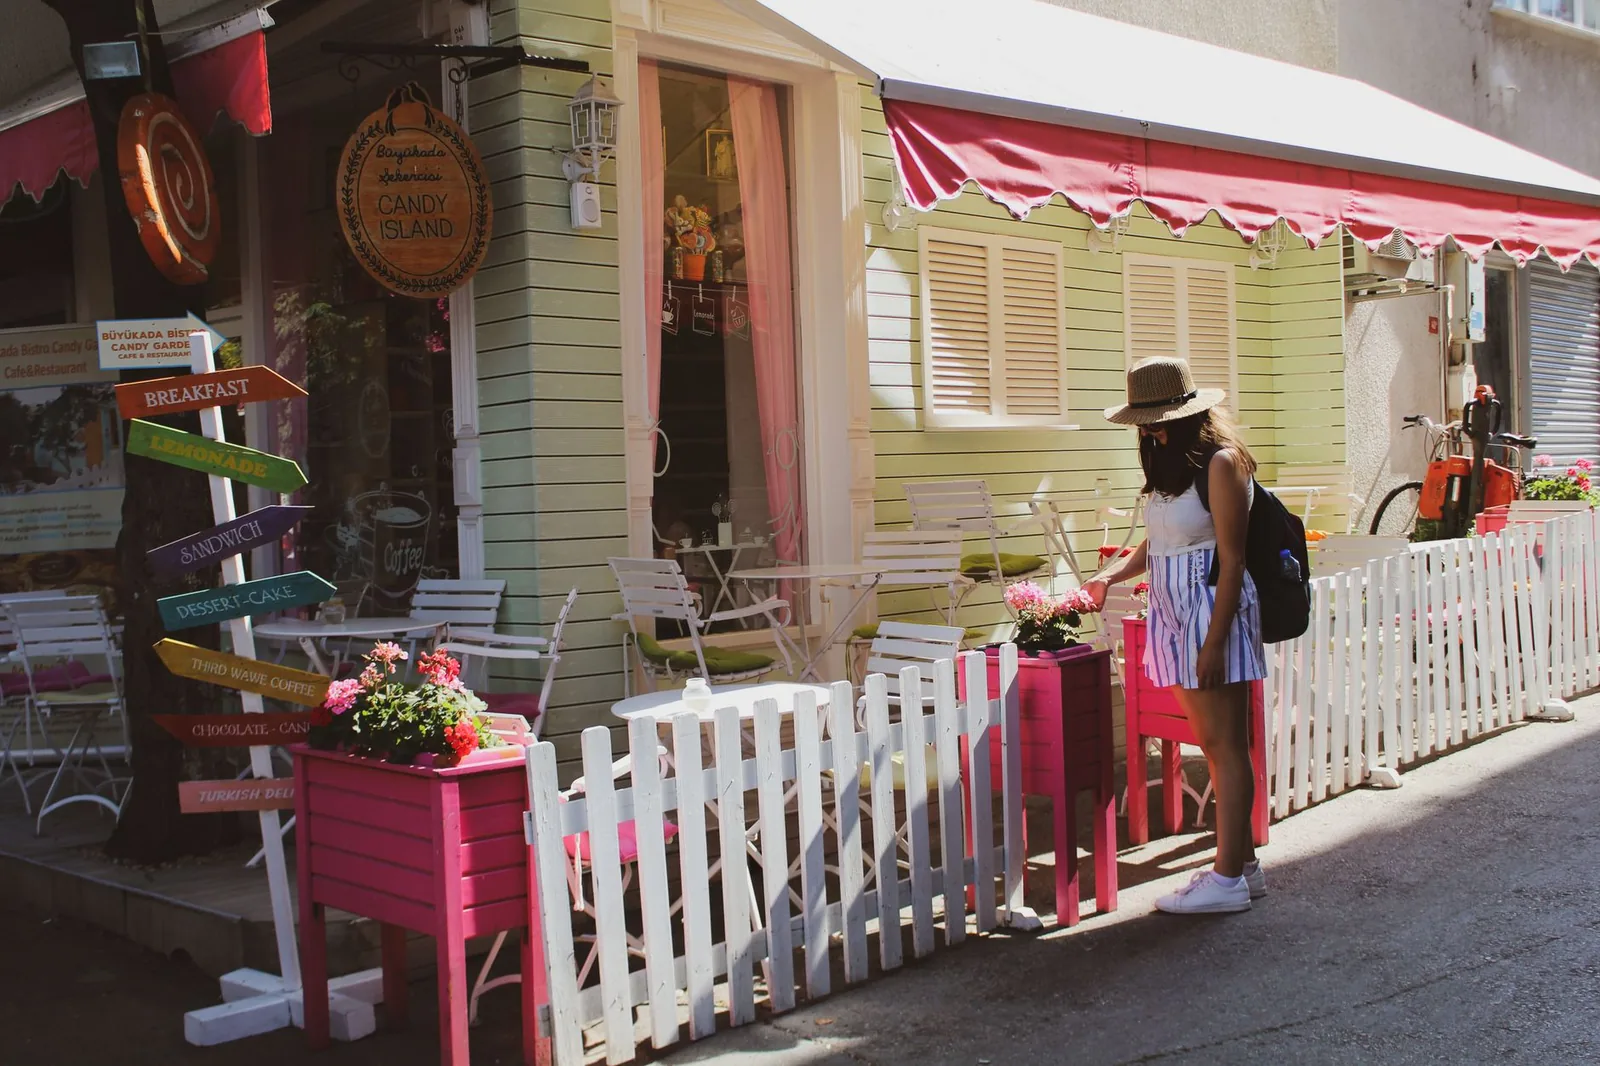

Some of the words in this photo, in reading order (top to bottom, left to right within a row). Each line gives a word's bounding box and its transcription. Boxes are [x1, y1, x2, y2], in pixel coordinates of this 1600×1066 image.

[378, 194, 448, 215] CANDY
[380, 219, 453, 240] ISLAND
[102, 330, 163, 341] BÜYÜKADA
[167, 327, 206, 338] BİST
[21, 343, 50, 356] Bistro
[52, 339, 82, 354] Candy
[111, 342, 149, 352] CANDY
[144, 378, 250, 408] BREAKFAST
[150, 435, 268, 478] LEMONADE
[181, 520, 263, 565] SANDWICH
[384, 538, 423, 576] Coffee
[176, 585, 297, 620] DESSERT-CAKE
[191, 657, 227, 676] THIRD
[230, 666, 267, 687] WAWE
[270, 676, 316, 698] COFFEE
[192, 723, 269, 737] CHOCOLATE
[199, 788, 260, 802] TURKISH
